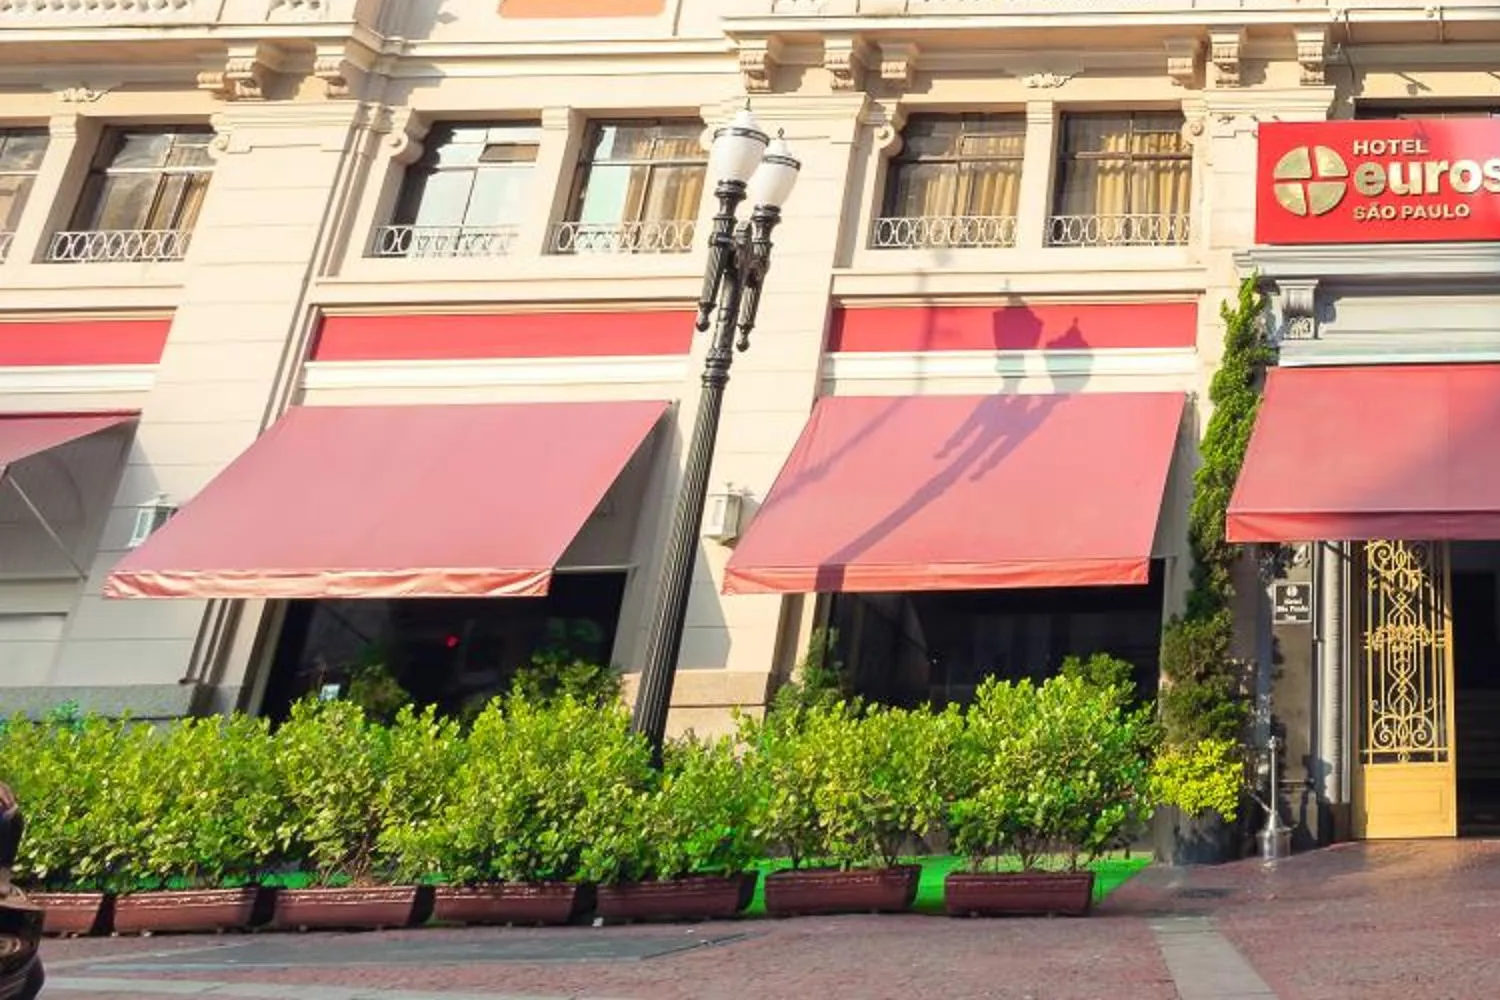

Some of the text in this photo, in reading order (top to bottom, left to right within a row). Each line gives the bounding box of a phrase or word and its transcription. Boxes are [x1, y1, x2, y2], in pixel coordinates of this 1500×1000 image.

[1353, 139, 1429, 155] HOTEL
[1353, 202, 1469, 219] SÃO PAULO
